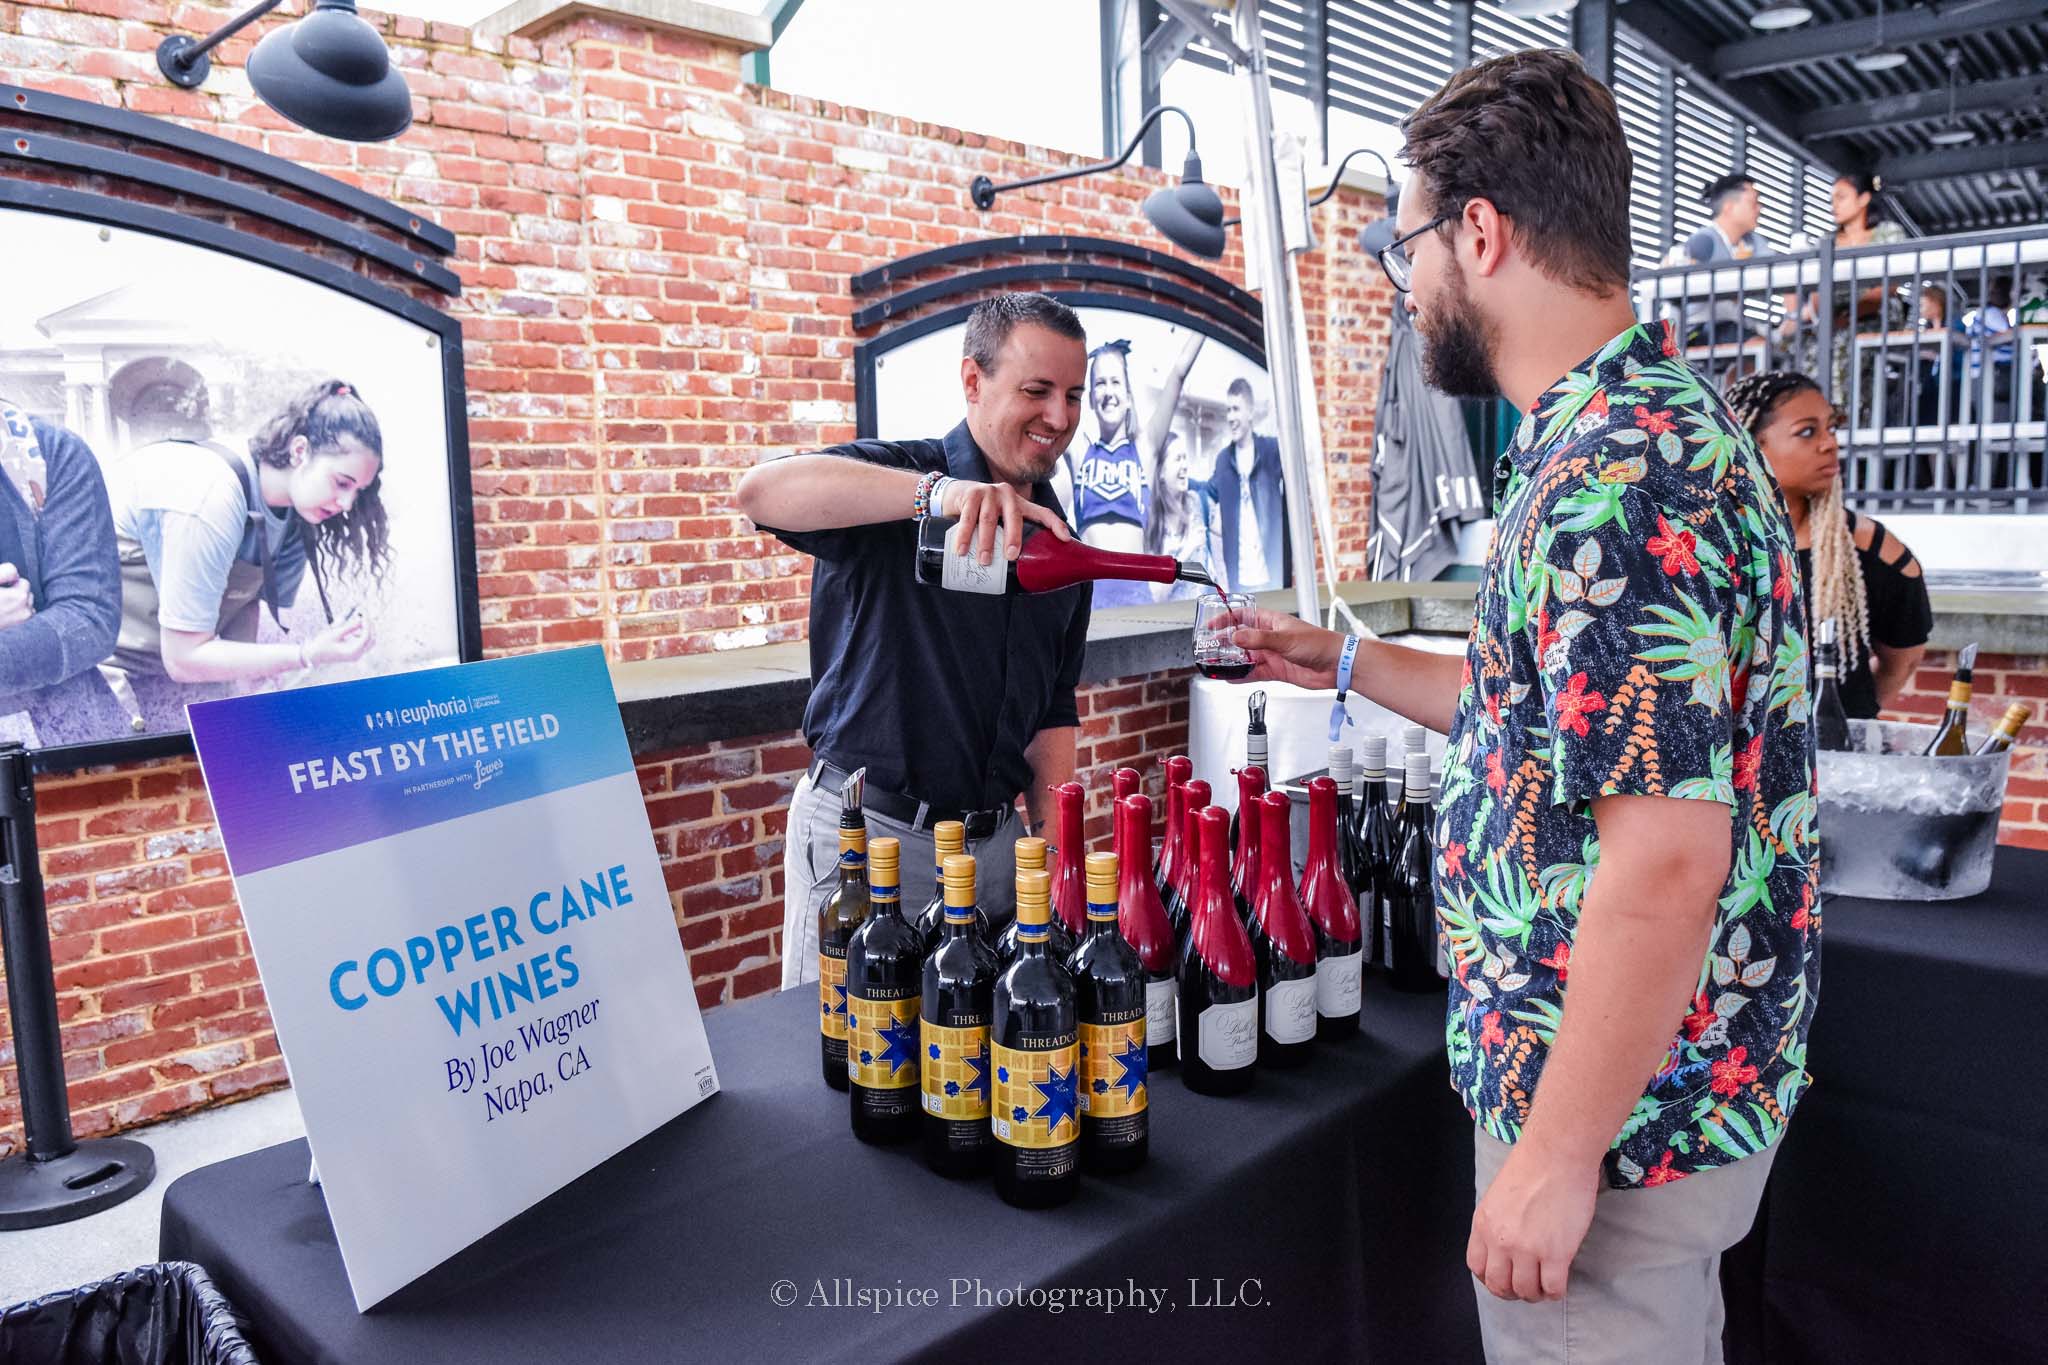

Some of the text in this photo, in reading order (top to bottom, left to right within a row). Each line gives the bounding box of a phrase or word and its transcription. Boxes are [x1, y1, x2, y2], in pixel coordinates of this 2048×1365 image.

[401, 696, 467, 725] euphoria
[288, 713, 560, 794] FEAST BY THE FIELD
[412, 776, 455, 794] PARTNERSHIP
[455, 773, 473, 783] WITH
[473, 758, 504, 790] Lowes
[328, 864, 633, 1011] COPPER CANE
[825, 945, 846, 957] THRE
[435, 944, 580, 1038] WINES
[444, 999, 600, 1094] By Joe Wagner
[483, 1045, 592, 1122] Napa, CA
